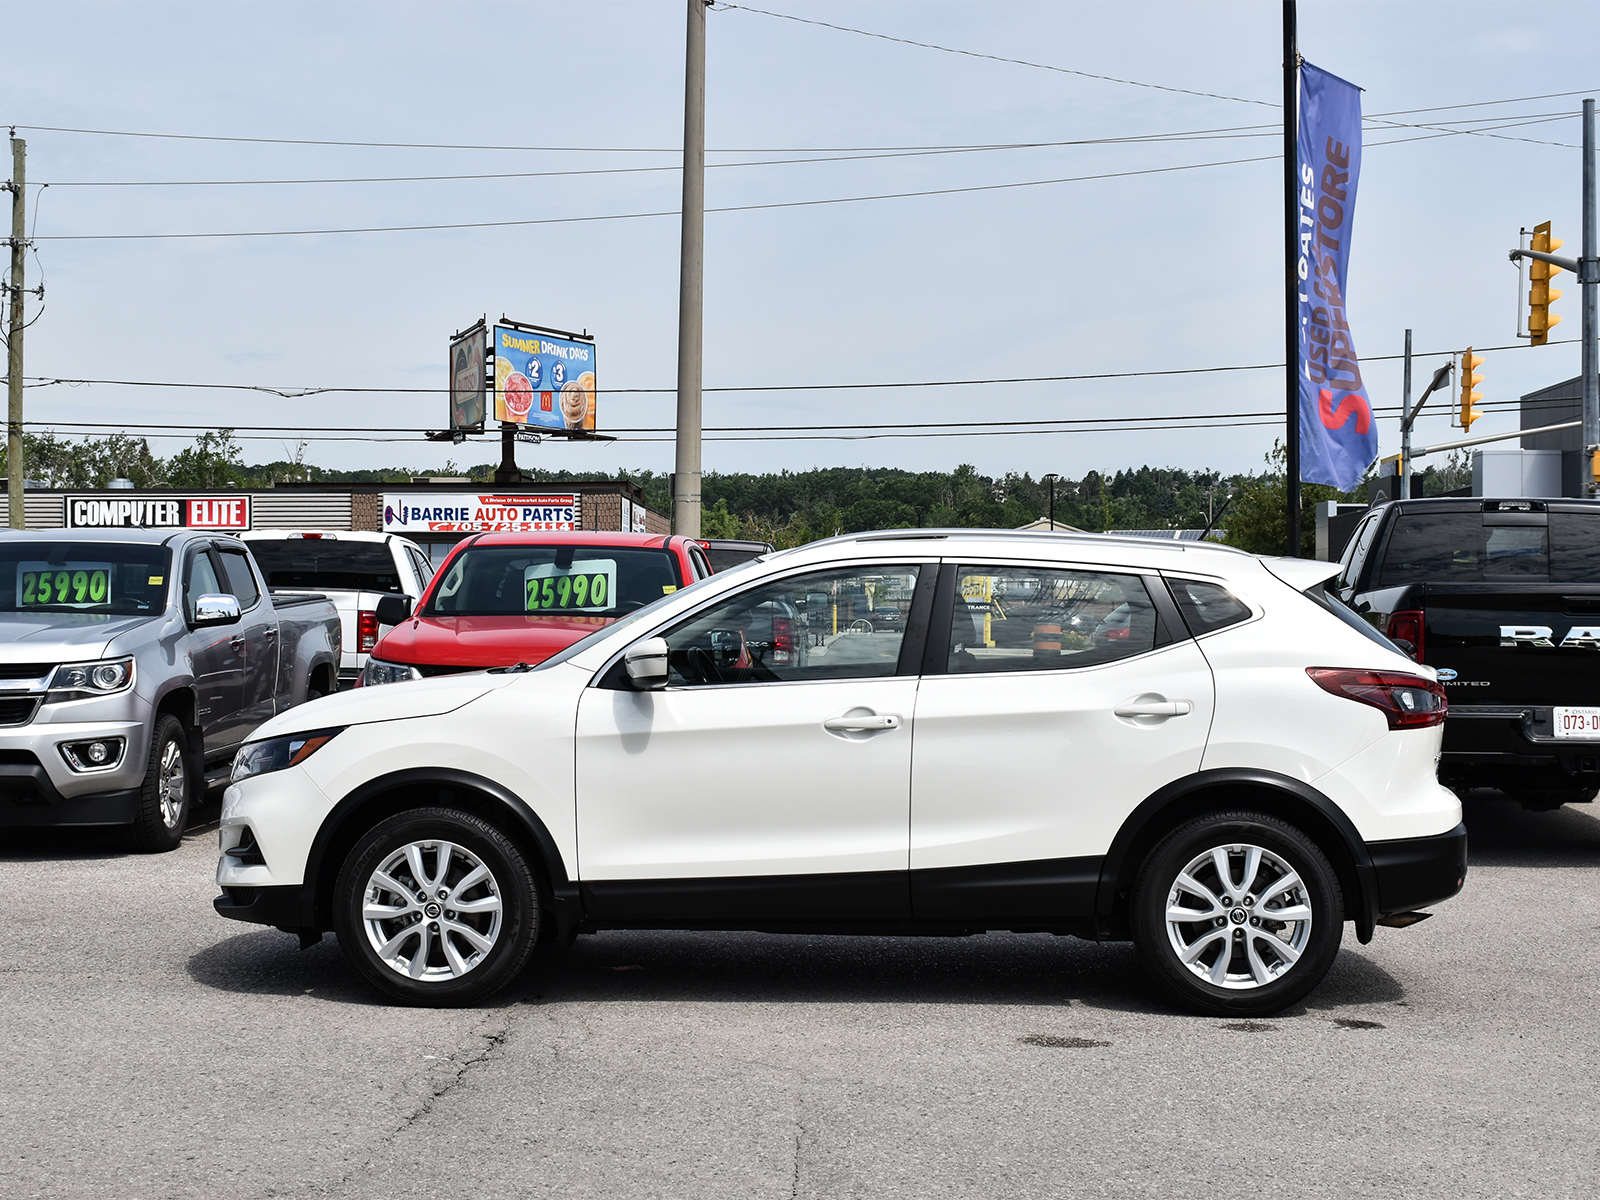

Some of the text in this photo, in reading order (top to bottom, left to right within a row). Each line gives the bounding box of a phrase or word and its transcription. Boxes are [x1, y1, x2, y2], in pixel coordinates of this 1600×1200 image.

[1317, 135, 1371, 436] SUPERSTORE
[502, 333, 589, 361] SUMMER DRINK DAYS
[1309, 306, 1331, 385] USED
[74, 500, 242, 526] COMPUTER ELITE
[411, 507, 573, 521] BARRIE AUTO PARTS
[450, 522, 570, 531] 705-725-1114
[23, 570, 107, 604] 25990
[527, 573, 607, 610] 25990
